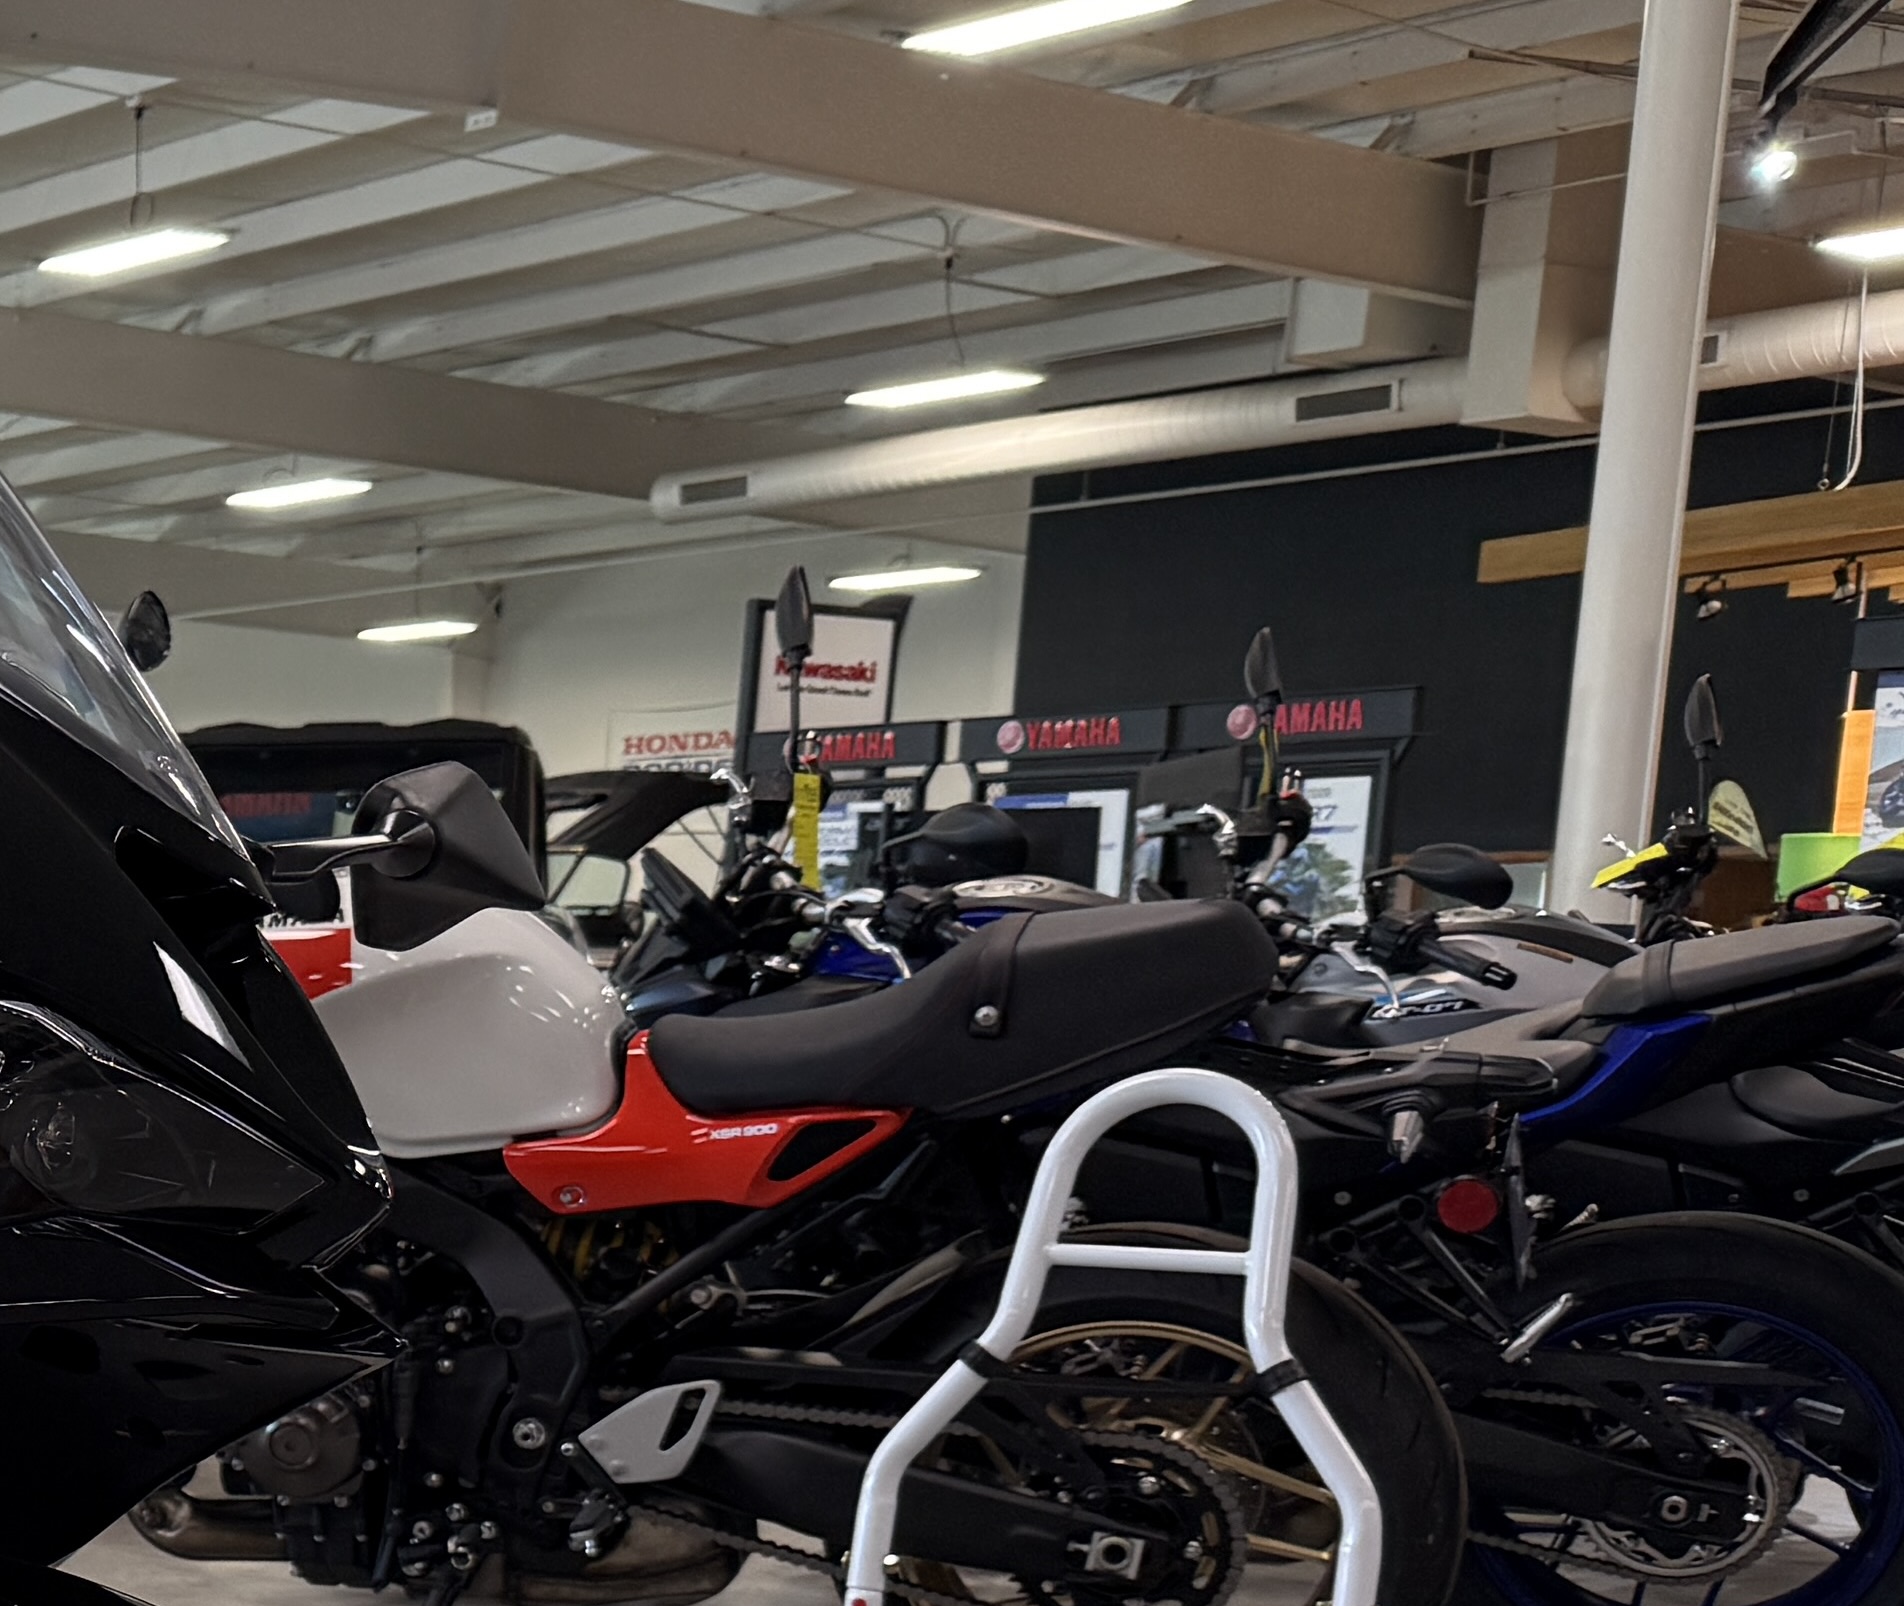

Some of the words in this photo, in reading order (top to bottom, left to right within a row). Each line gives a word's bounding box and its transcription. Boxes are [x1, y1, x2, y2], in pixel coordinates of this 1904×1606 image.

[1026, 716, 1121, 750] YAMAHA
[1274, 699, 1364, 736] AMAHA
[623, 729, 735, 756] HONDA
